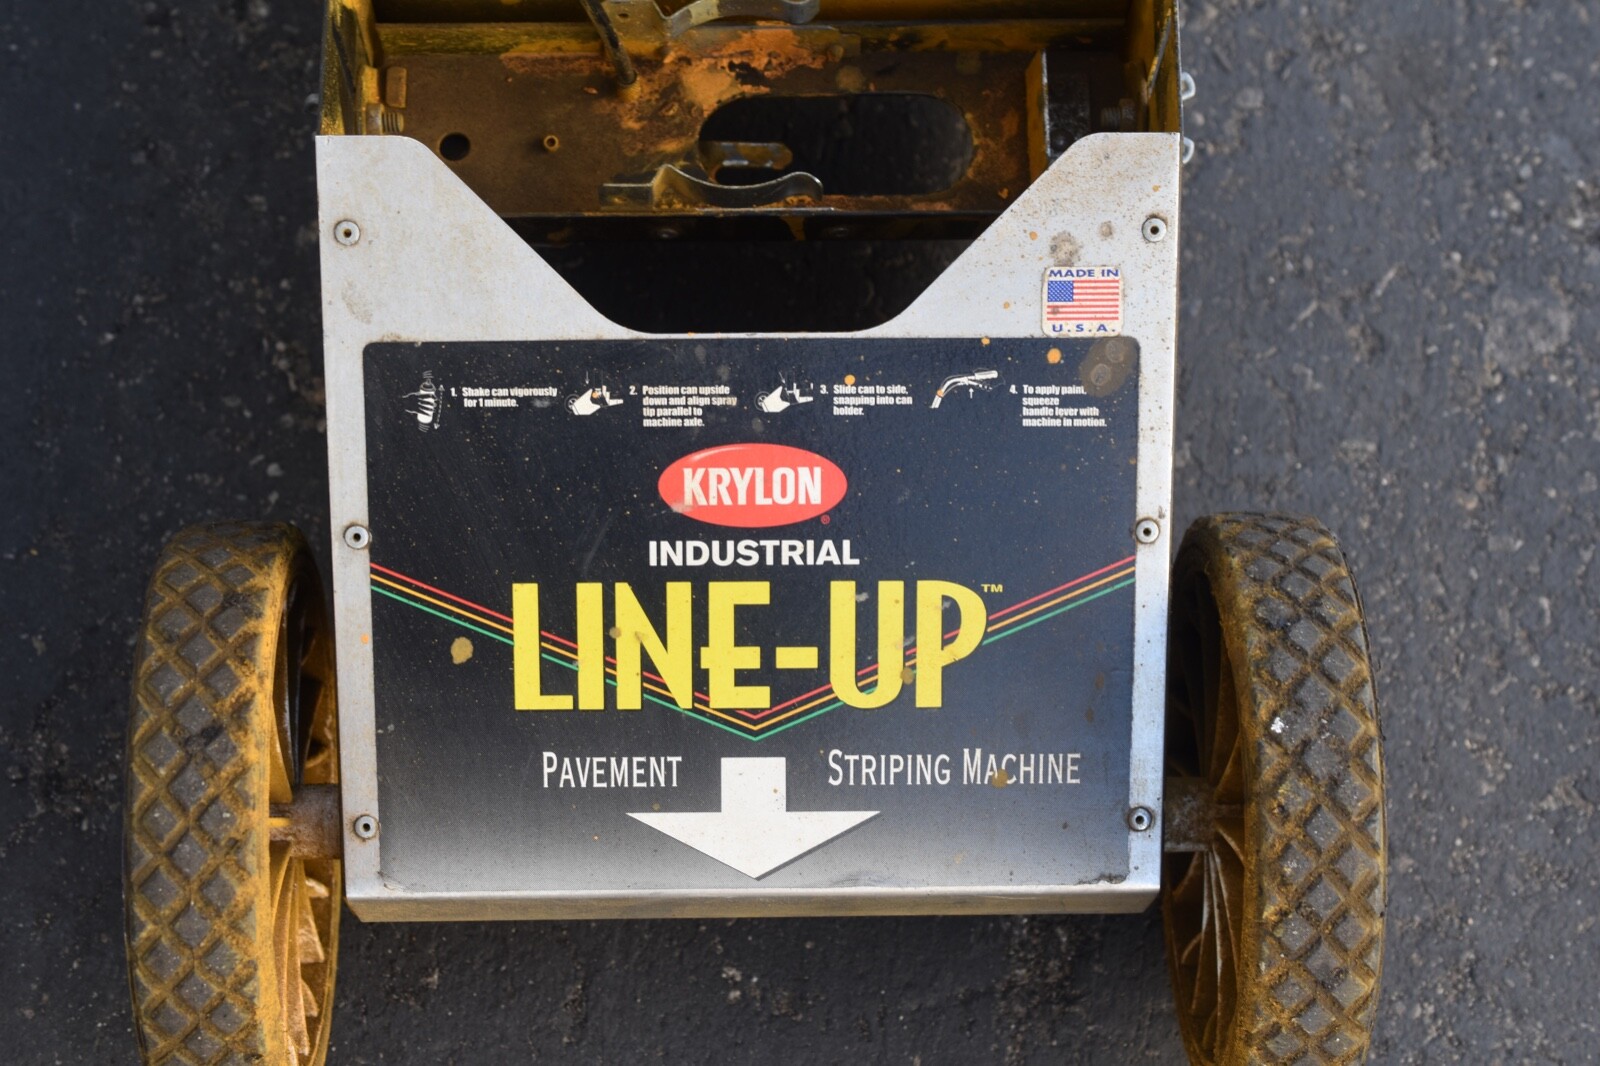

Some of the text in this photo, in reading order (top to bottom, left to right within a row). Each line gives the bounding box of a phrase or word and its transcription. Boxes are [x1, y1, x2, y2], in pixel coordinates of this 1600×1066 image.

[1048, 269, 1119, 277] MADE IN
[450, 386, 558, 397] 1. Shake can vigorously
[629, 385, 730, 395] 2. Position can upside
[820, 384, 829, 394] 3.
[833, 384, 857, 394] Slide
[857, 385, 875, 394] can
[876, 385, 886, 394] to
[1009, 384, 1018, 394] 4.
[1022, 384, 1034, 394] To
[1035, 385, 1060, 394] apply
[463, 398, 519, 407] for 1 minute.
[642, 396, 738, 406] down and align spray
[833, 395, 913, 406] snapping into can
[1022, 397, 1060, 406] squeeze
[642, 407, 703, 417] tip parallel to
[833, 405, 865, 415] holder.
[1022, 406, 1100, 416] handle lever with
[642, 417, 706, 427] machine axle.
[1022, 417, 1108, 427] machine in motion.
[683, 467, 822, 506] KRYLON
[649, 539, 860, 566] INDUSTRIAL
[512, 580, 987, 710] LINE-UP
[542, 751, 682, 788] PAVEMENT
[828, 748, 1081, 786] STRIPING MACHINE
